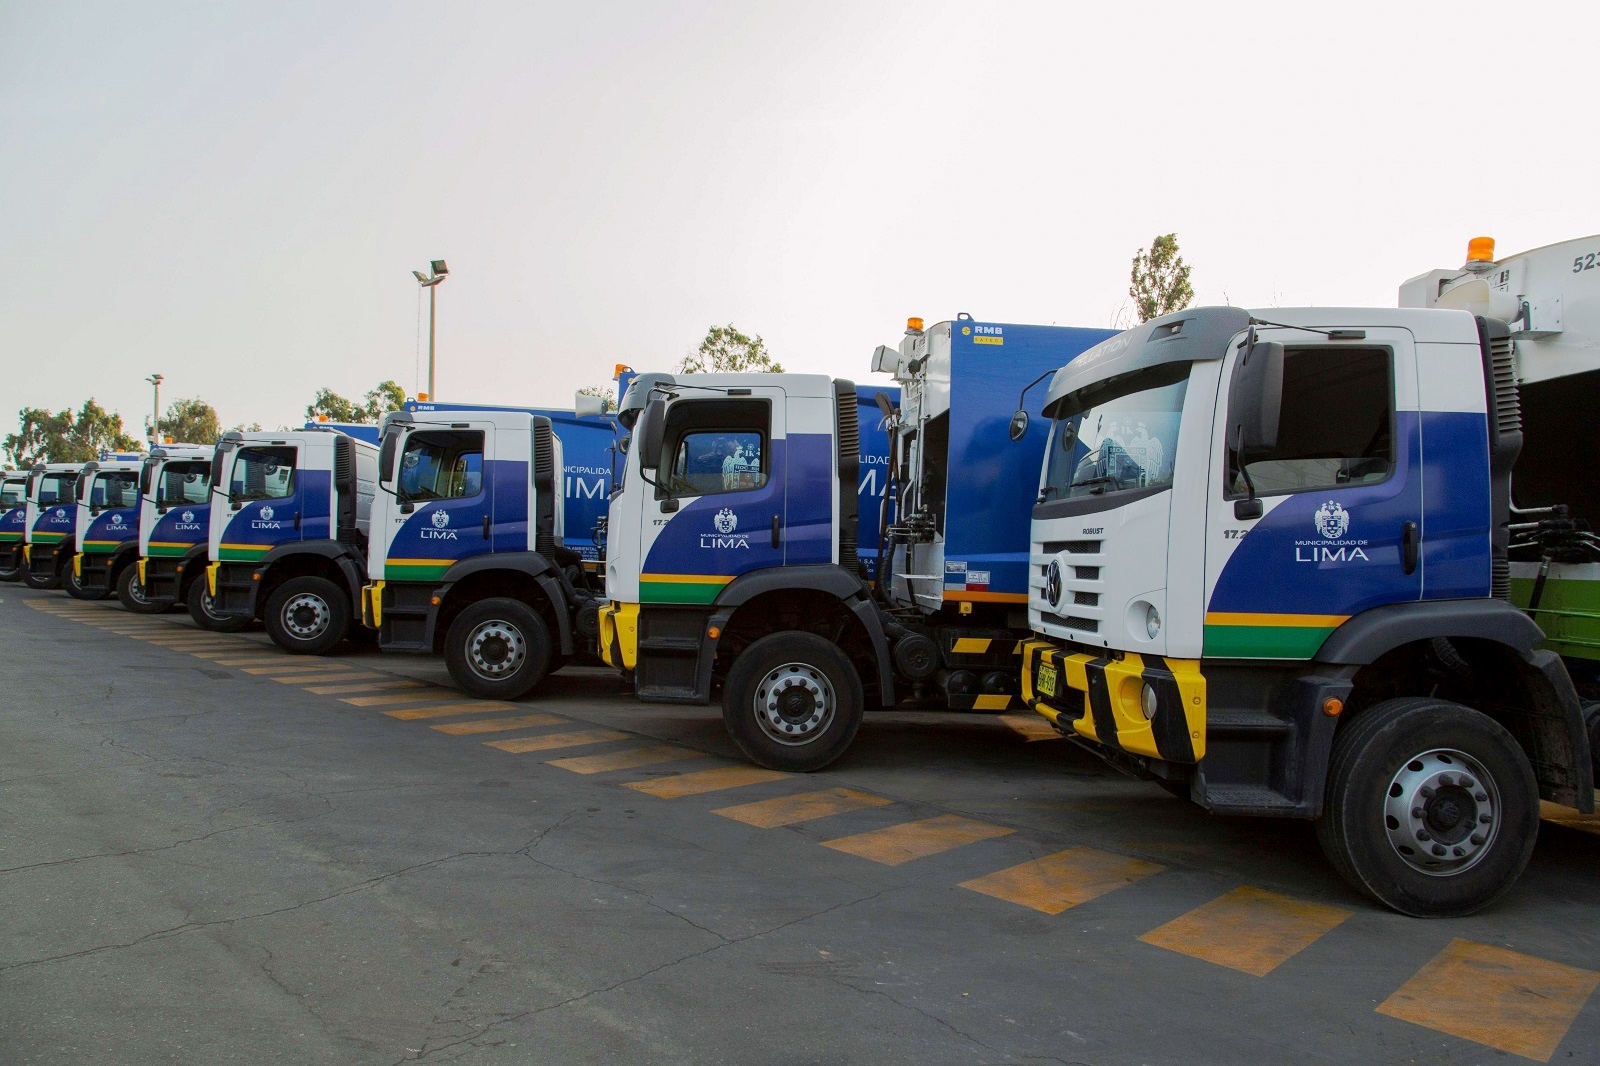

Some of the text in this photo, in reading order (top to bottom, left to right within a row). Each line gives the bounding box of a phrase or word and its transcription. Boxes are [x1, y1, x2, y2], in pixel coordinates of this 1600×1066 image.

[974, 325, 1003, 335] RMB
[566, 476, 612, 500] IM
[251, 522, 281, 530] LIMA
[1082, 527, 1104, 535] ROBUST
[420, 530, 458, 540] LIMA
[700, 538, 750, 549] LIMA
[1295, 547, 1370, 562] LIMA
